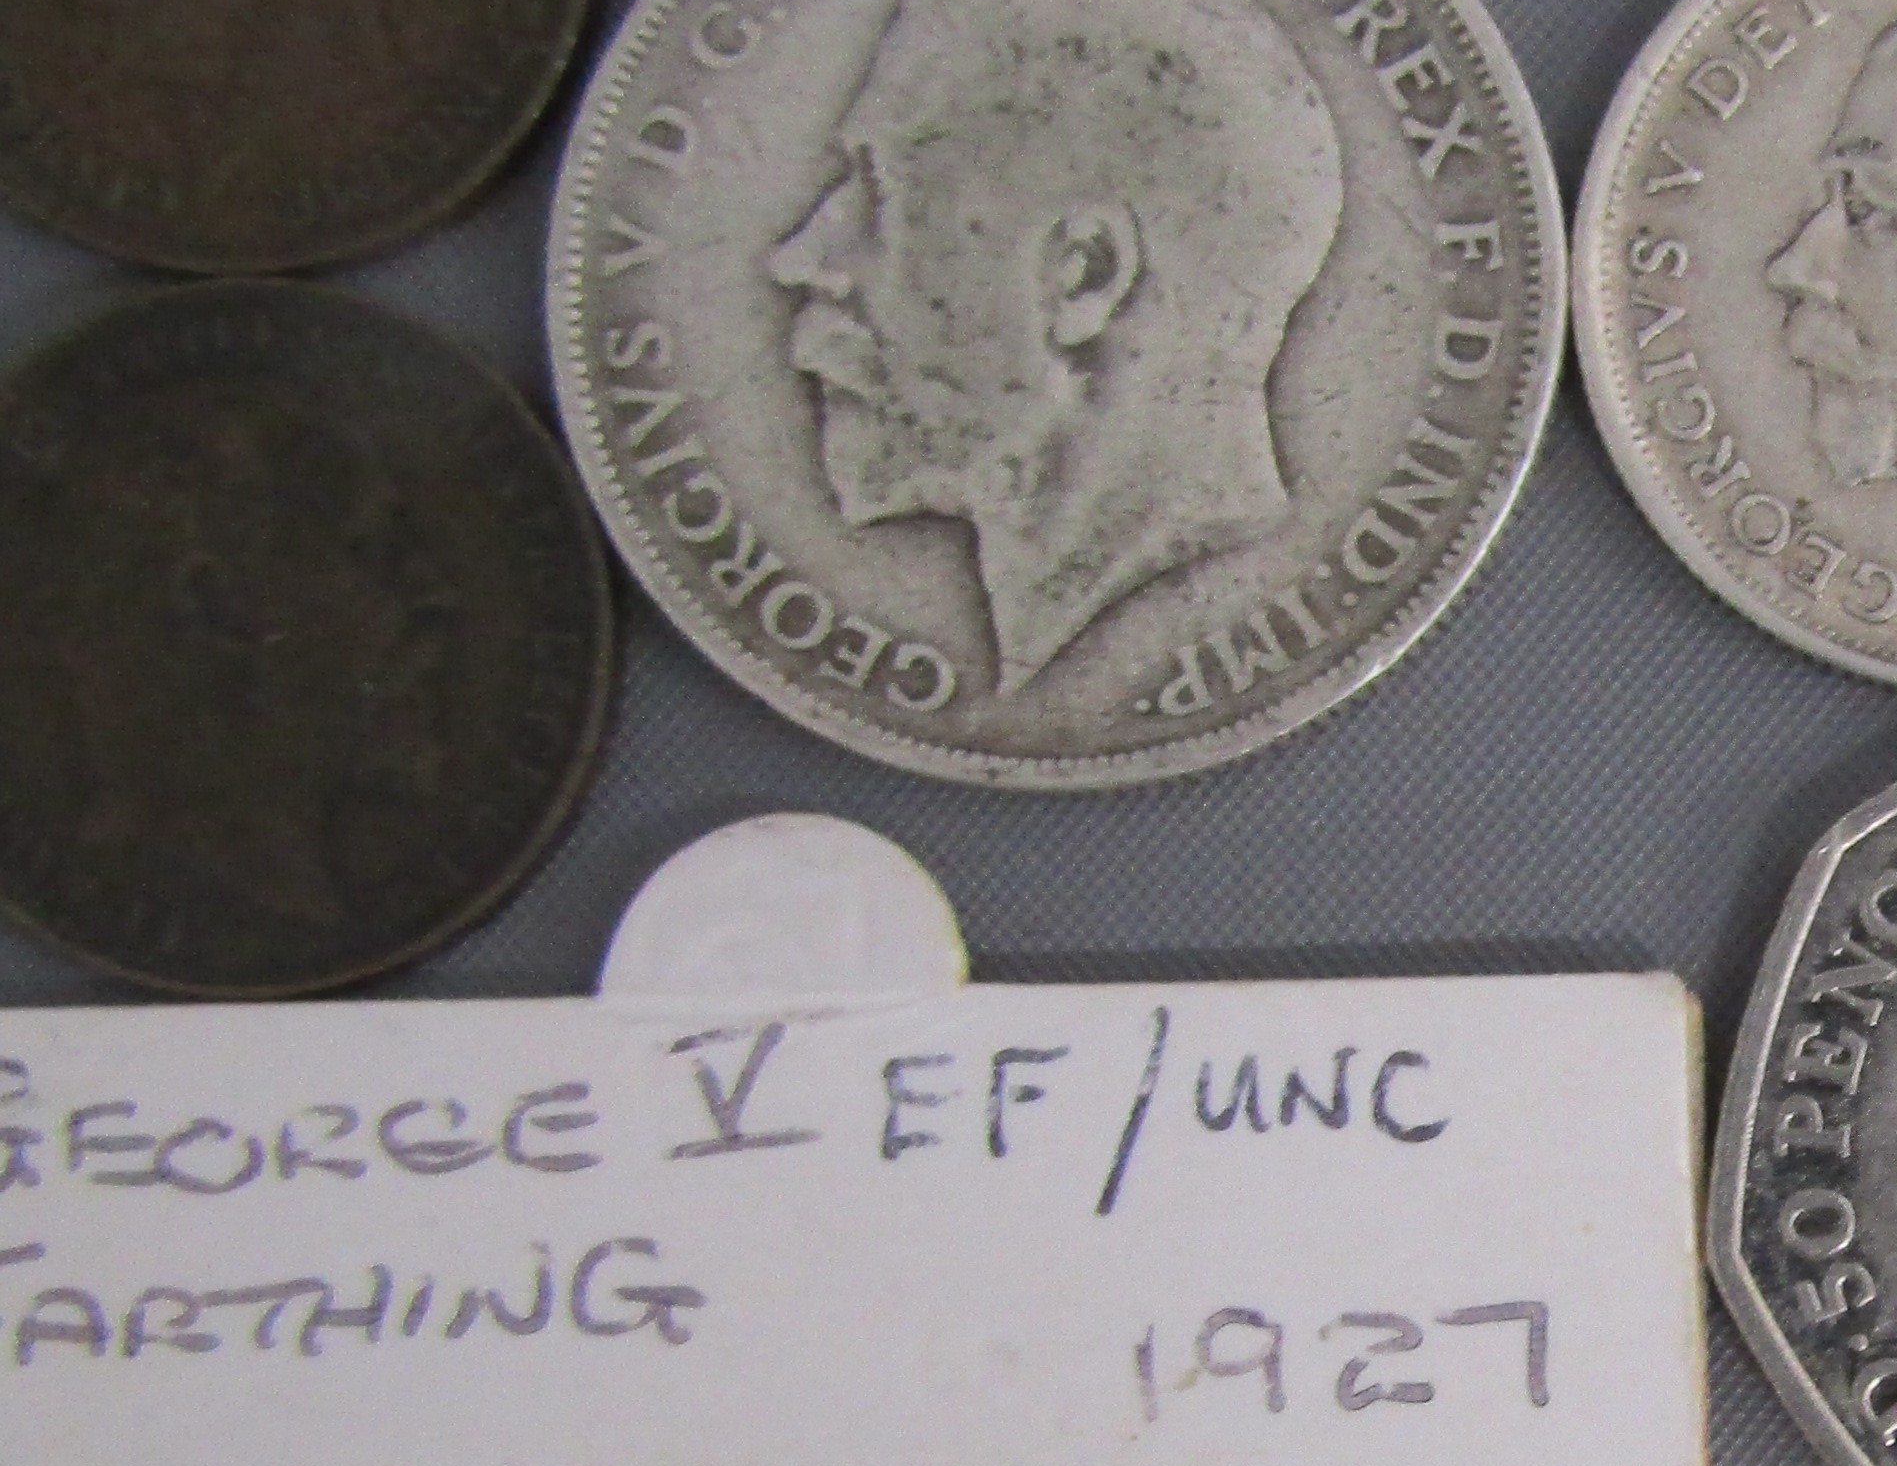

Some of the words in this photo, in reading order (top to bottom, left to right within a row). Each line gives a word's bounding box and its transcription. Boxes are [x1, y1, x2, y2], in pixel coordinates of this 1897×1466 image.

[1645, 139, 1705, 196] V
[602, 217, 668, 281] V
[608, 320, 957, 715] GEORGIVS
[665, 1019, 822, 1161] V
[0, 1236, 712, 1365] ARTHING
[1781, 1186, 1878, 1325] 50
[1135, 1298, 1553, 1425] 1927
